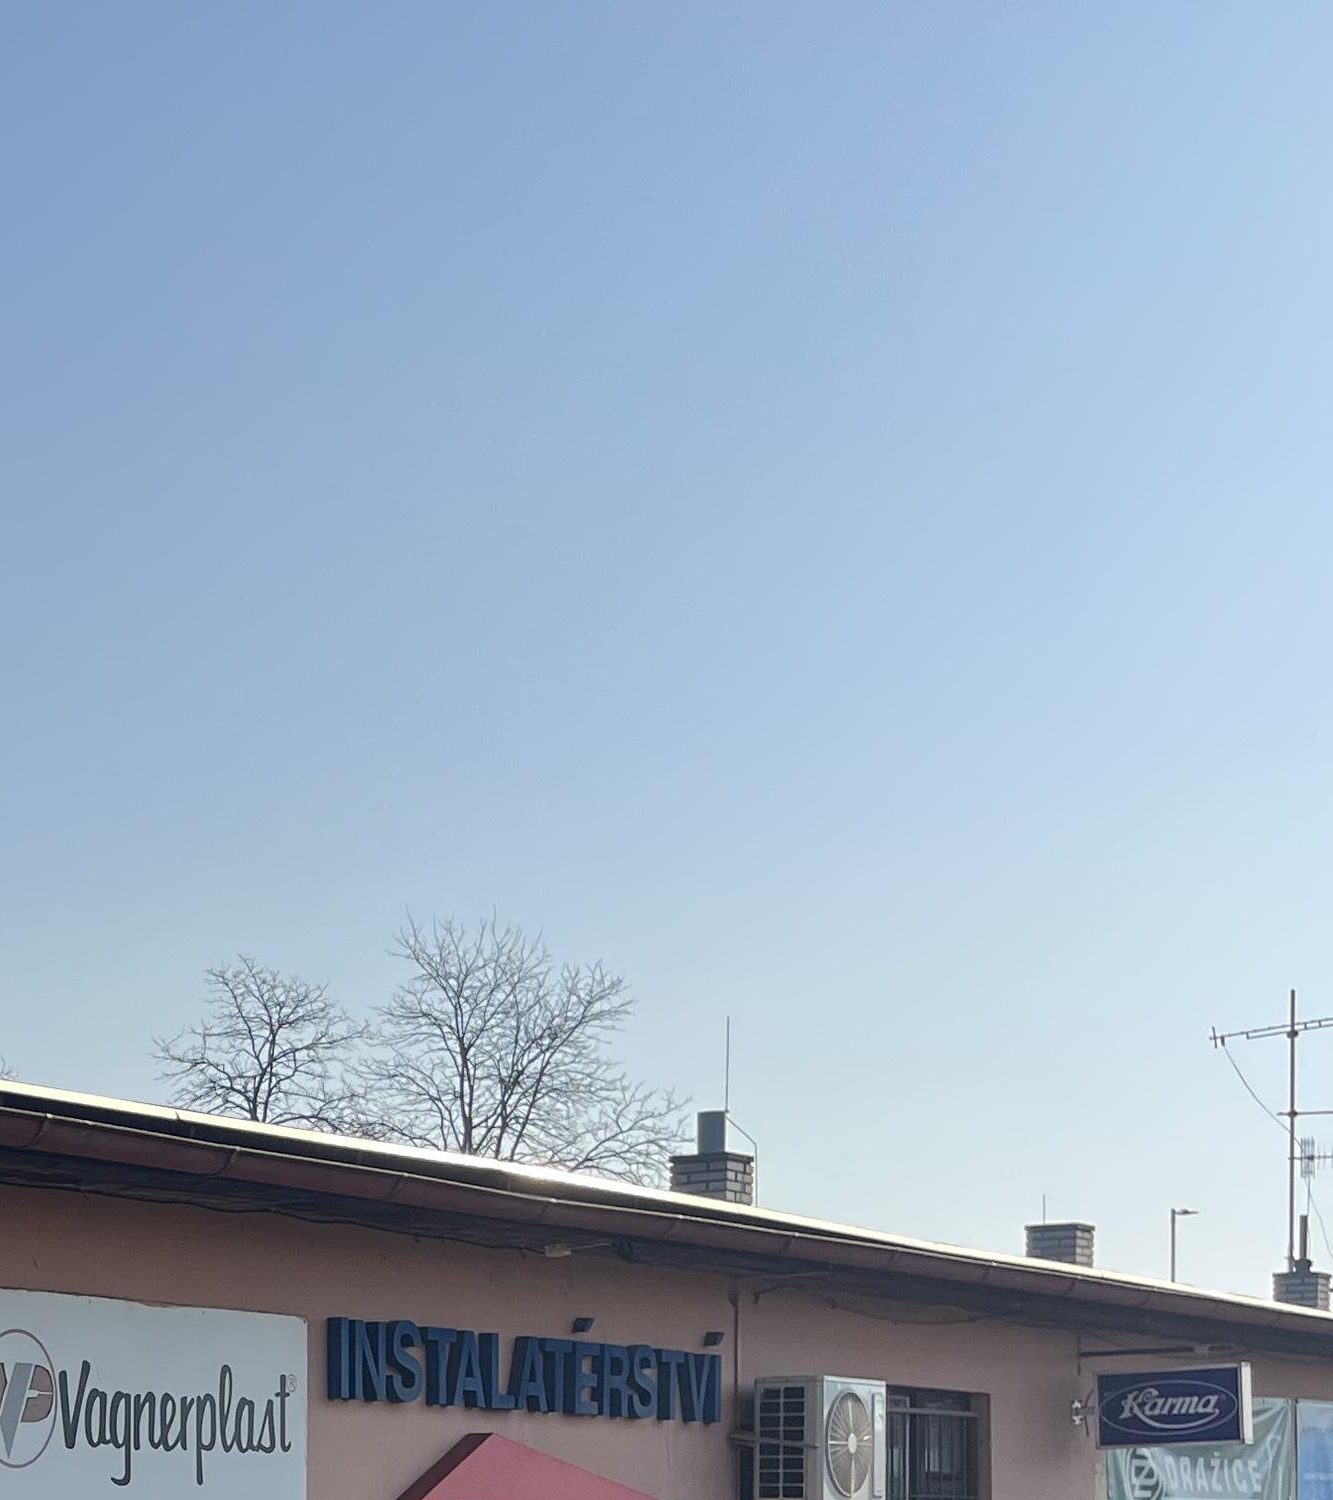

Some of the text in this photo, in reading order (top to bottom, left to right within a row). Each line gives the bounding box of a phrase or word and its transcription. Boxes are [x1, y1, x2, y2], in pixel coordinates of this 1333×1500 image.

[327, 1316, 725, 1424] INSTALATÉRSTVÍ
[59, 1360, 291, 1485] Vagnerplast
[1119, 1388, 1221, 1429] Karma
[1165, 1452, 1262, 1494] DRAŽICE
